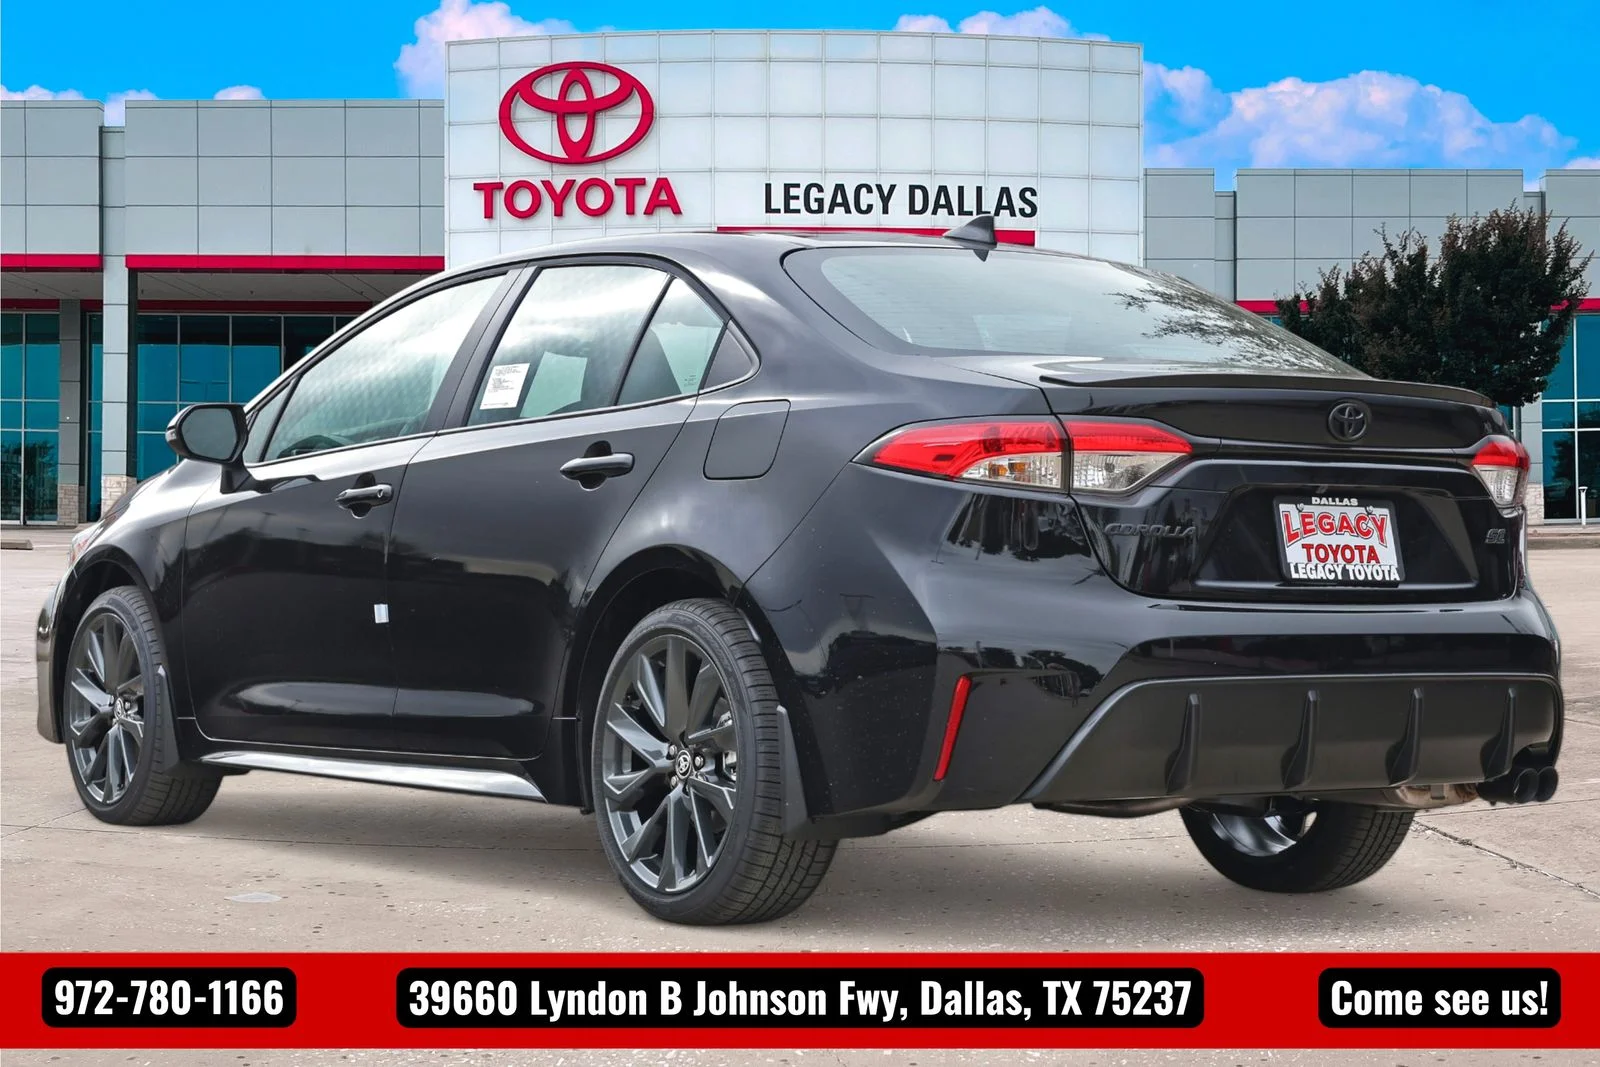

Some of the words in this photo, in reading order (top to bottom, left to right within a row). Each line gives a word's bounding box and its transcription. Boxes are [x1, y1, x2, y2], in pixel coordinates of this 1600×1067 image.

[474, 177, 681, 219] TOYOTA
[765, 183, 896, 214] LEGACY
[908, 185, 1038, 218] DALLAS
[1311, 497, 1359, 506] DALLAS
[1104, 523, 1197, 537] COROLLA
[1281, 510, 1388, 548] LEGACY
[1484, 528, 1506, 544] SE
[1302, 543, 1381, 564] TOYOTA
[1290, 563, 1343, 580] LEGACY
[1346, 564, 1401, 581] TOYOTA
